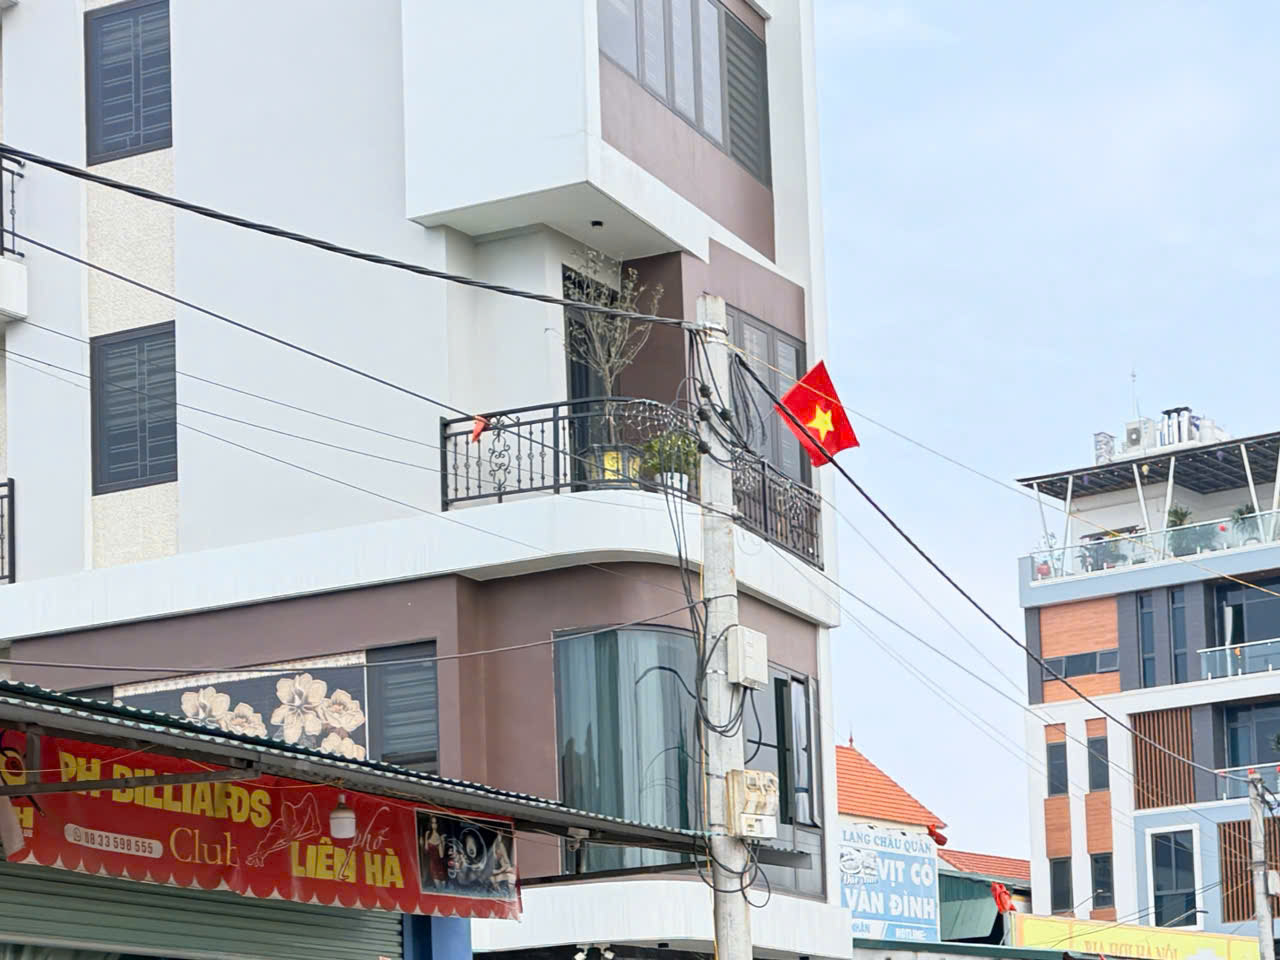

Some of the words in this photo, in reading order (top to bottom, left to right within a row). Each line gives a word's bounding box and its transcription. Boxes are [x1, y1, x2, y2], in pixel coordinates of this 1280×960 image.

[60, 750, 101, 798] PH
[112, 763, 272, 828] BILLIARDS
[842, 830, 870, 845] LANG
[290, 836, 357, 883] LIÊN
[364, 847, 404, 889] HÀ
[878, 858, 905, 887] VỊT
[889, 890, 936, 920] ĐÌNH
